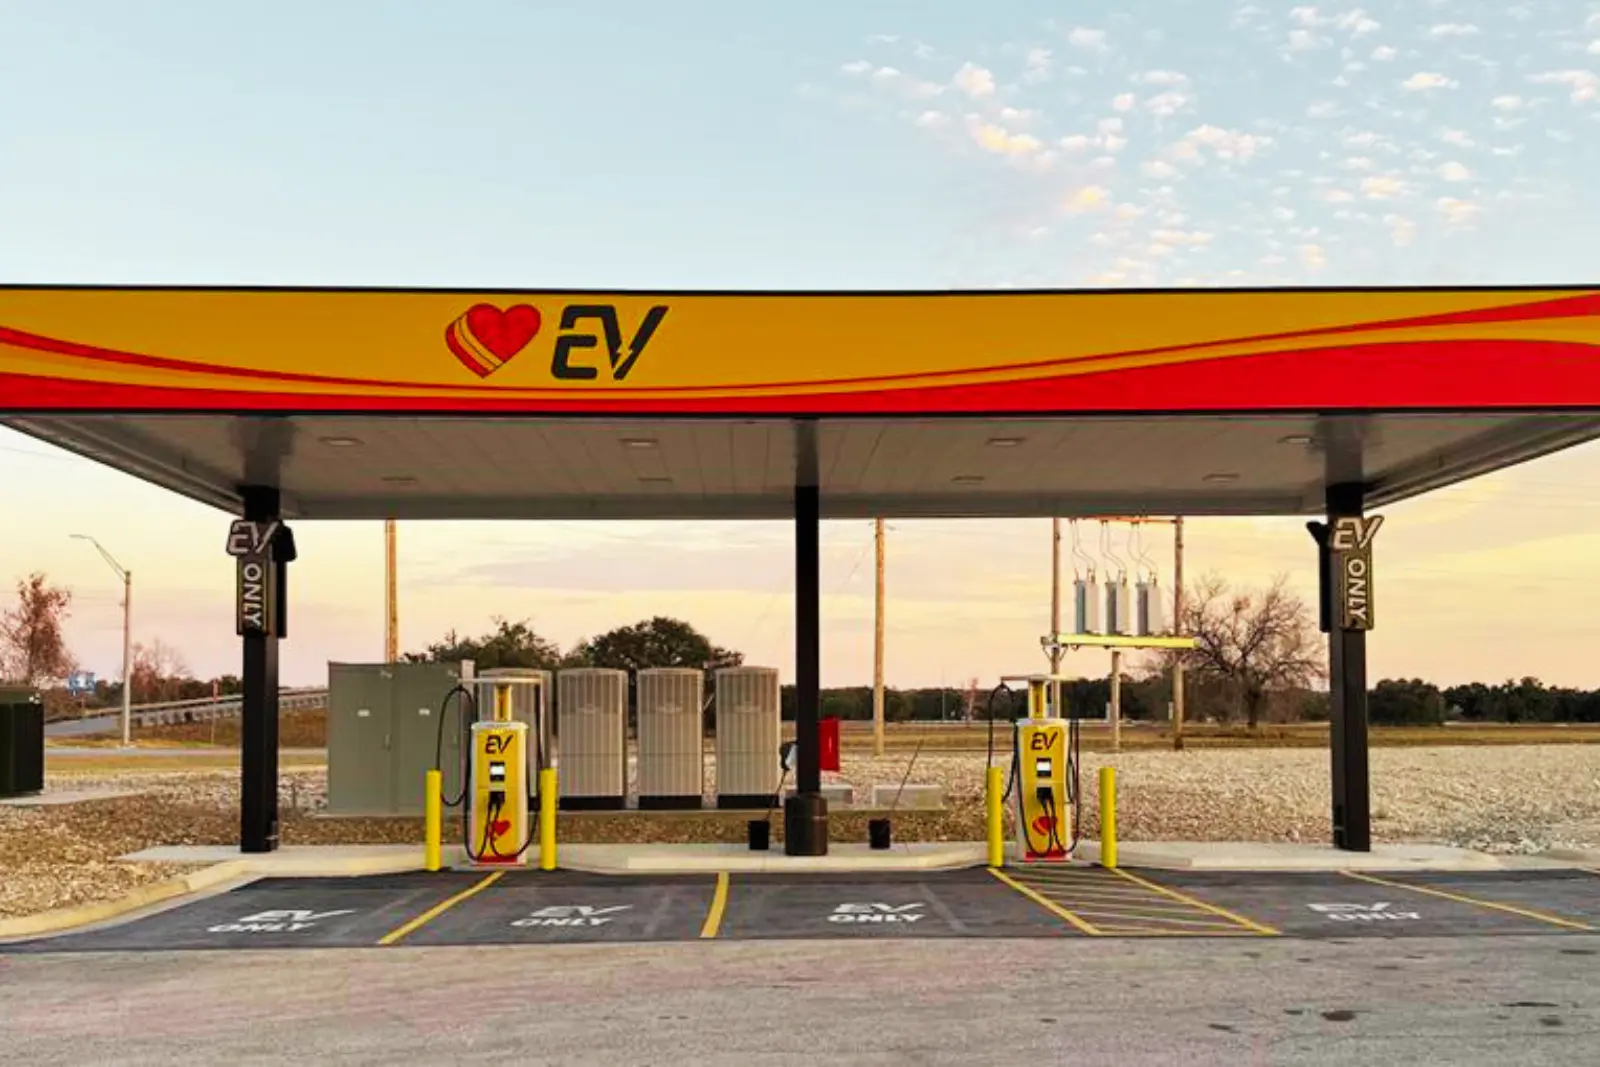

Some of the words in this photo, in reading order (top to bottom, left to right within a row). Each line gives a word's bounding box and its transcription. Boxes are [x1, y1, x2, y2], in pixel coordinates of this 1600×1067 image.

[551, 304, 669, 380] EV
[229, 520, 279, 554] EV
[1333, 516, 1384, 549] EV
[243, 562, 262, 630] ONLY
[1348, 558, 1367, 621] ONLY
[485, 734, 513, 754] EV
[1031, 731, 1058, 750] EV
[237, 909, 356, 922] EV
[530, 904, 634, 917] EV
[832, 902, 926, 913] EV
[207, 921, 316, 933] ONLY
[509, 917, 613, 927] ONLY
[826, 913, 926, 923] ONLY
